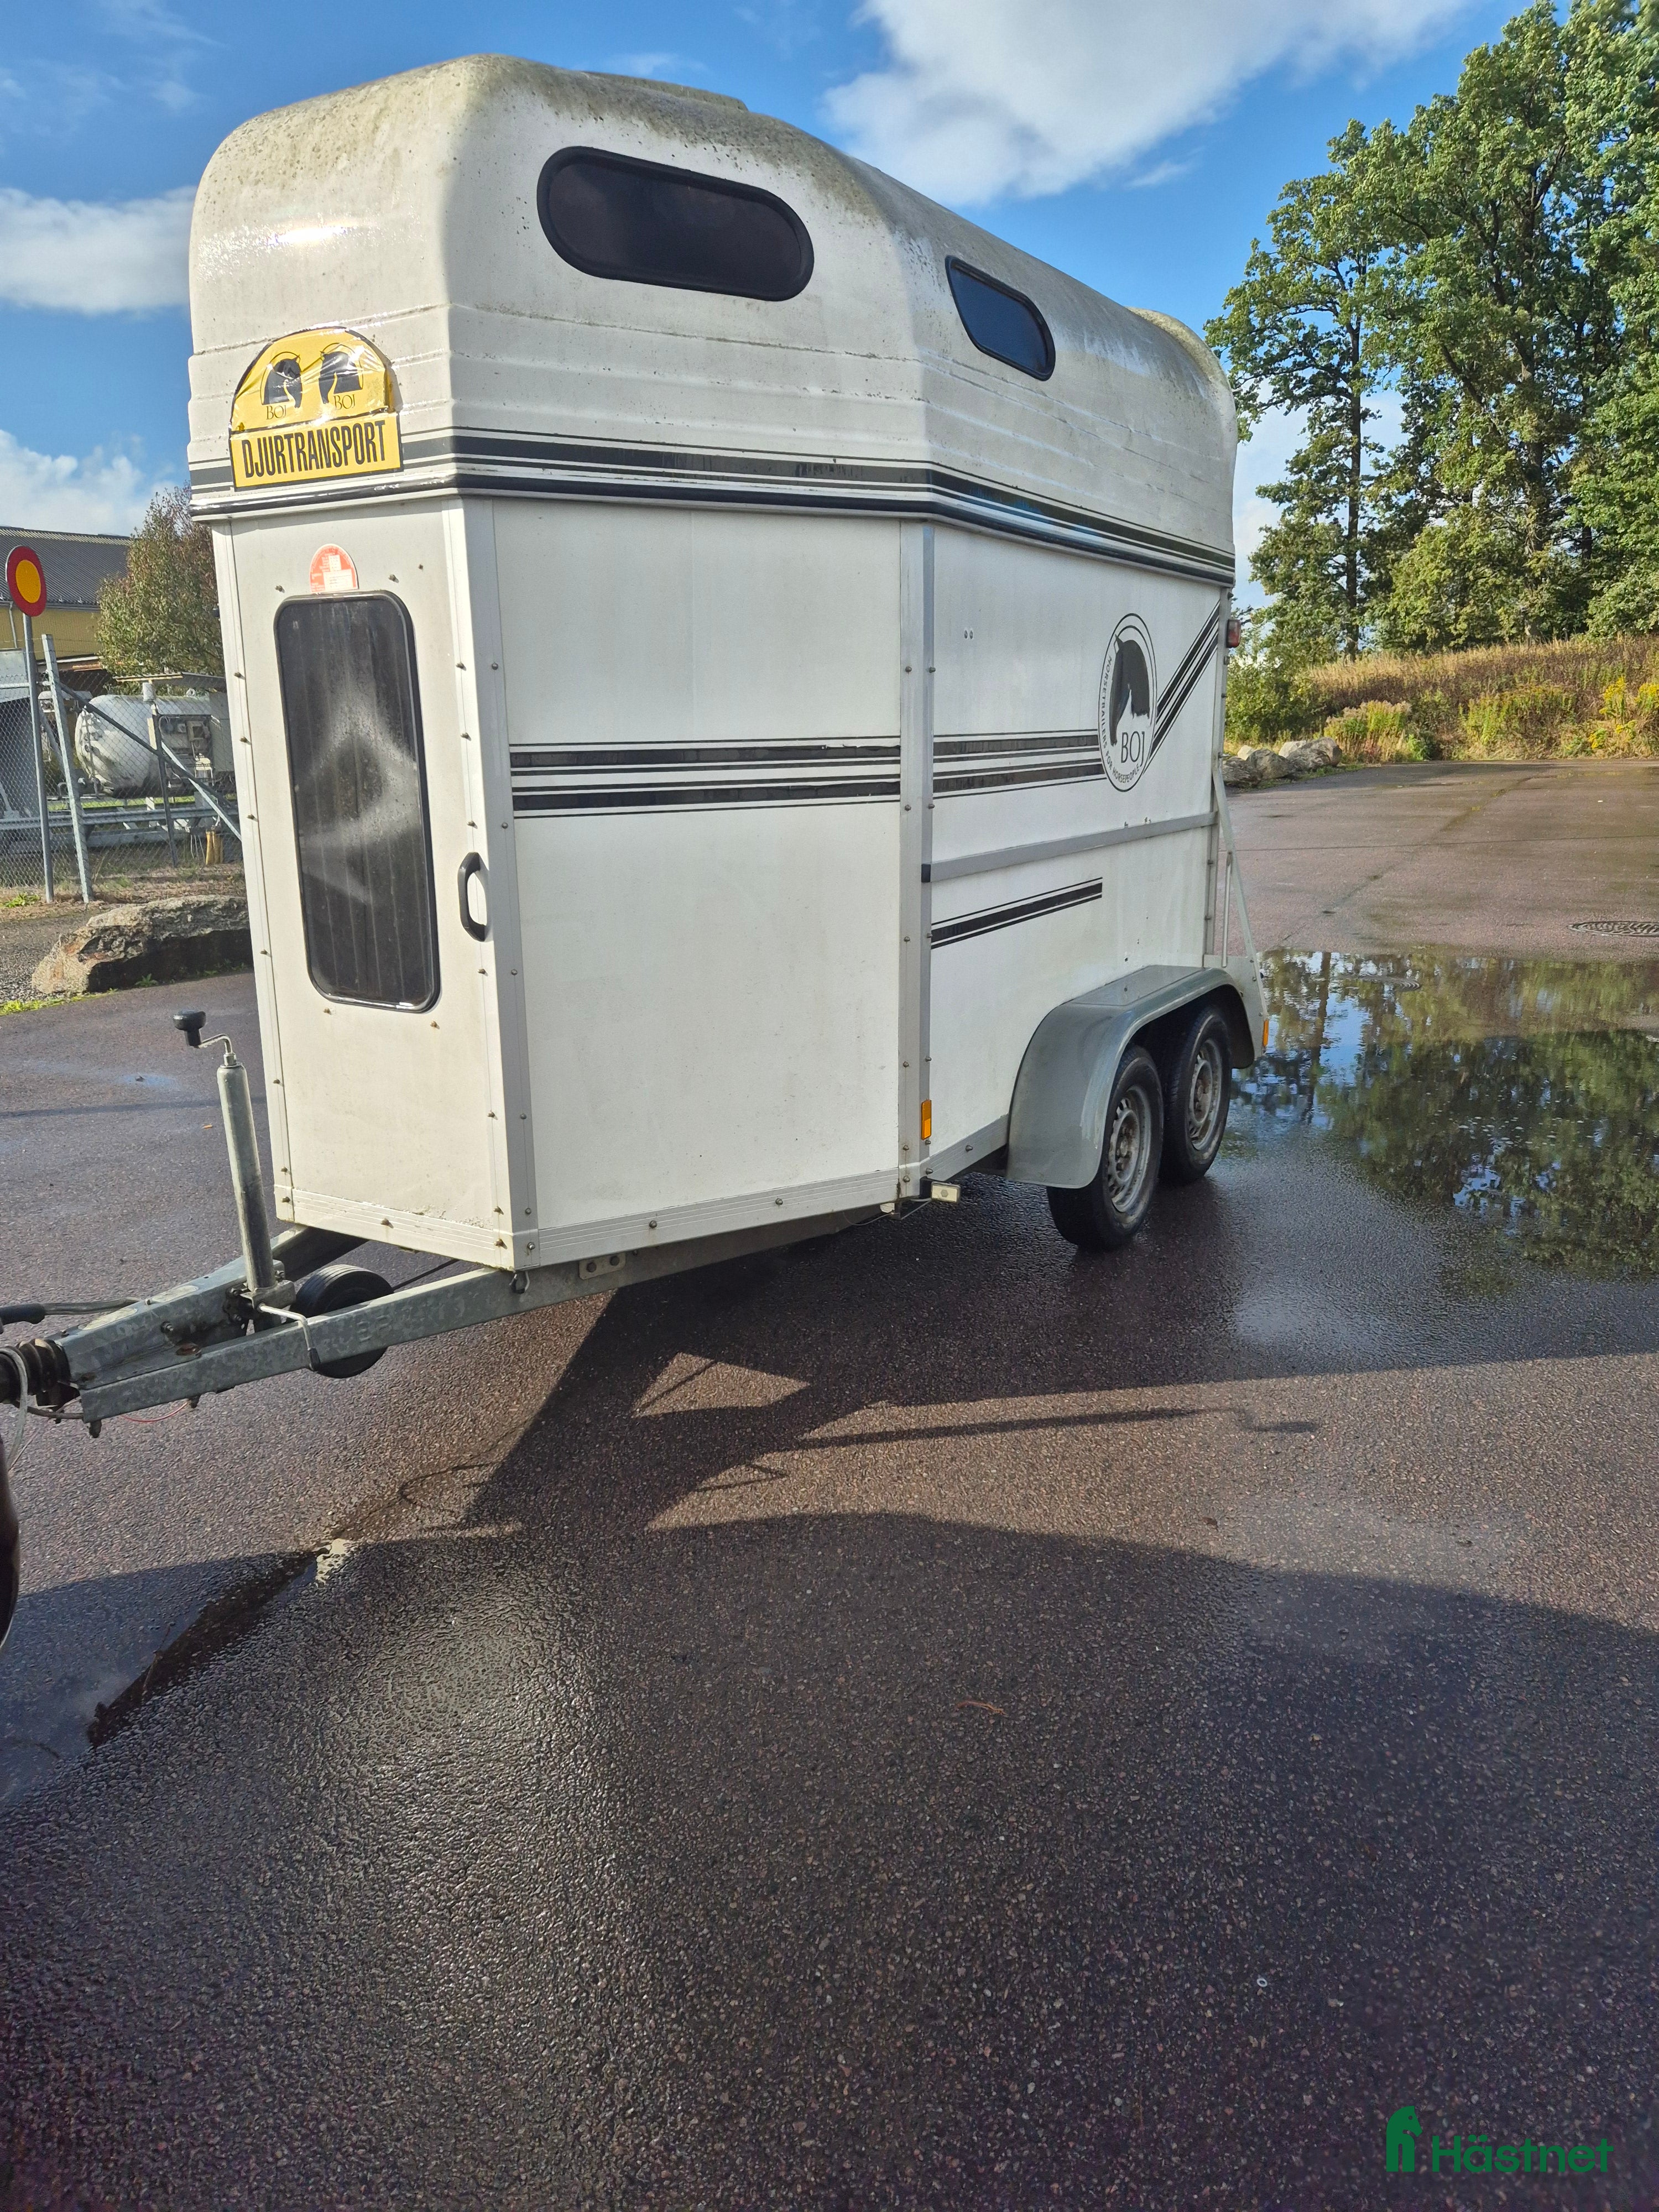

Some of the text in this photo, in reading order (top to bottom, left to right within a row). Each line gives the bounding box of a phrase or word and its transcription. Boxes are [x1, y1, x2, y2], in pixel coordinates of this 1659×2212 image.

[266, 405, 287, 420] BOJ
[333, 394, 356, 410] BOJ
[242, 420, 385, 479] DJURTRANSPORT
[1121, 731, 1145, 767] BOJ
